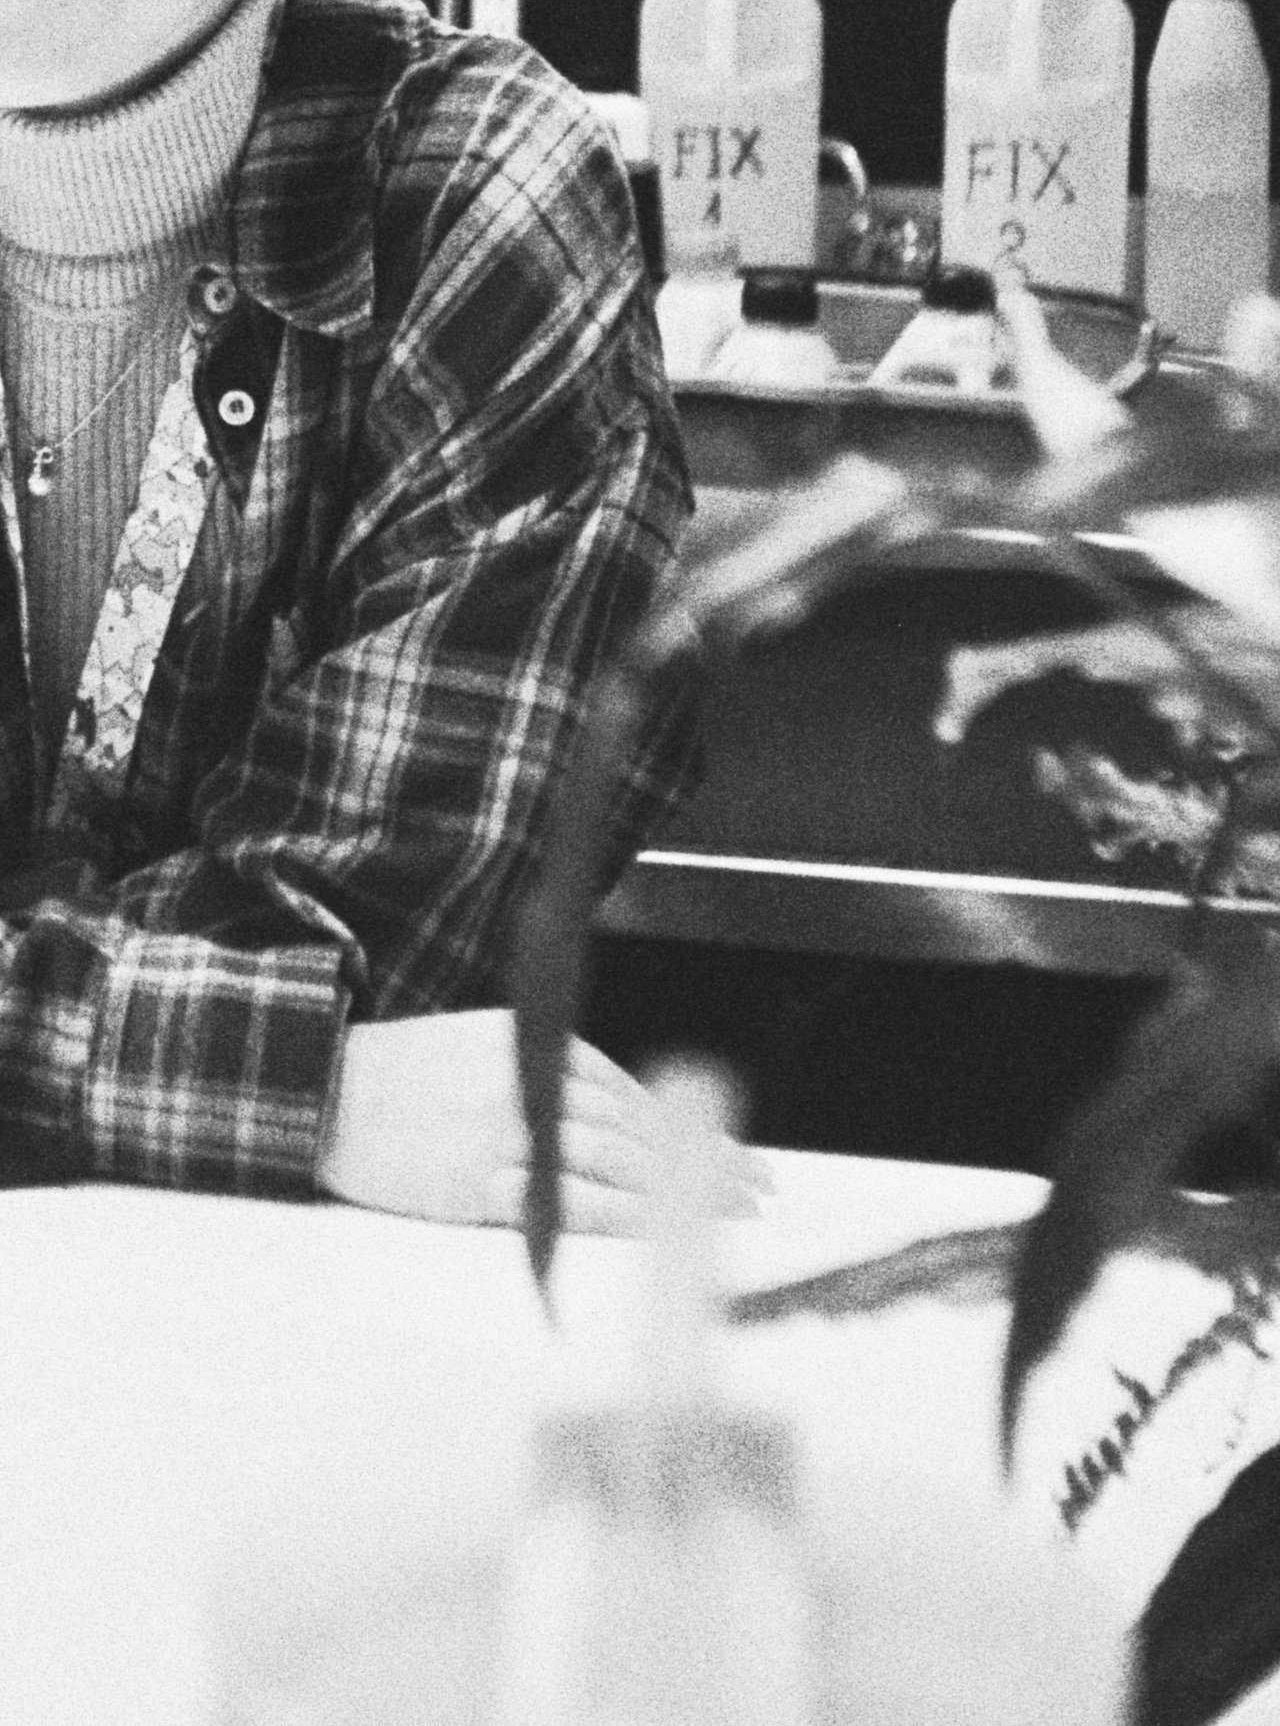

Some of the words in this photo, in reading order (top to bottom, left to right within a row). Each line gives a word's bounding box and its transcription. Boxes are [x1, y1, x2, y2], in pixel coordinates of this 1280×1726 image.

[673, 125, 765, 180] FIX
[966, 140, 1076, 205] FIX
[994, 219, 1030, 280] 2
